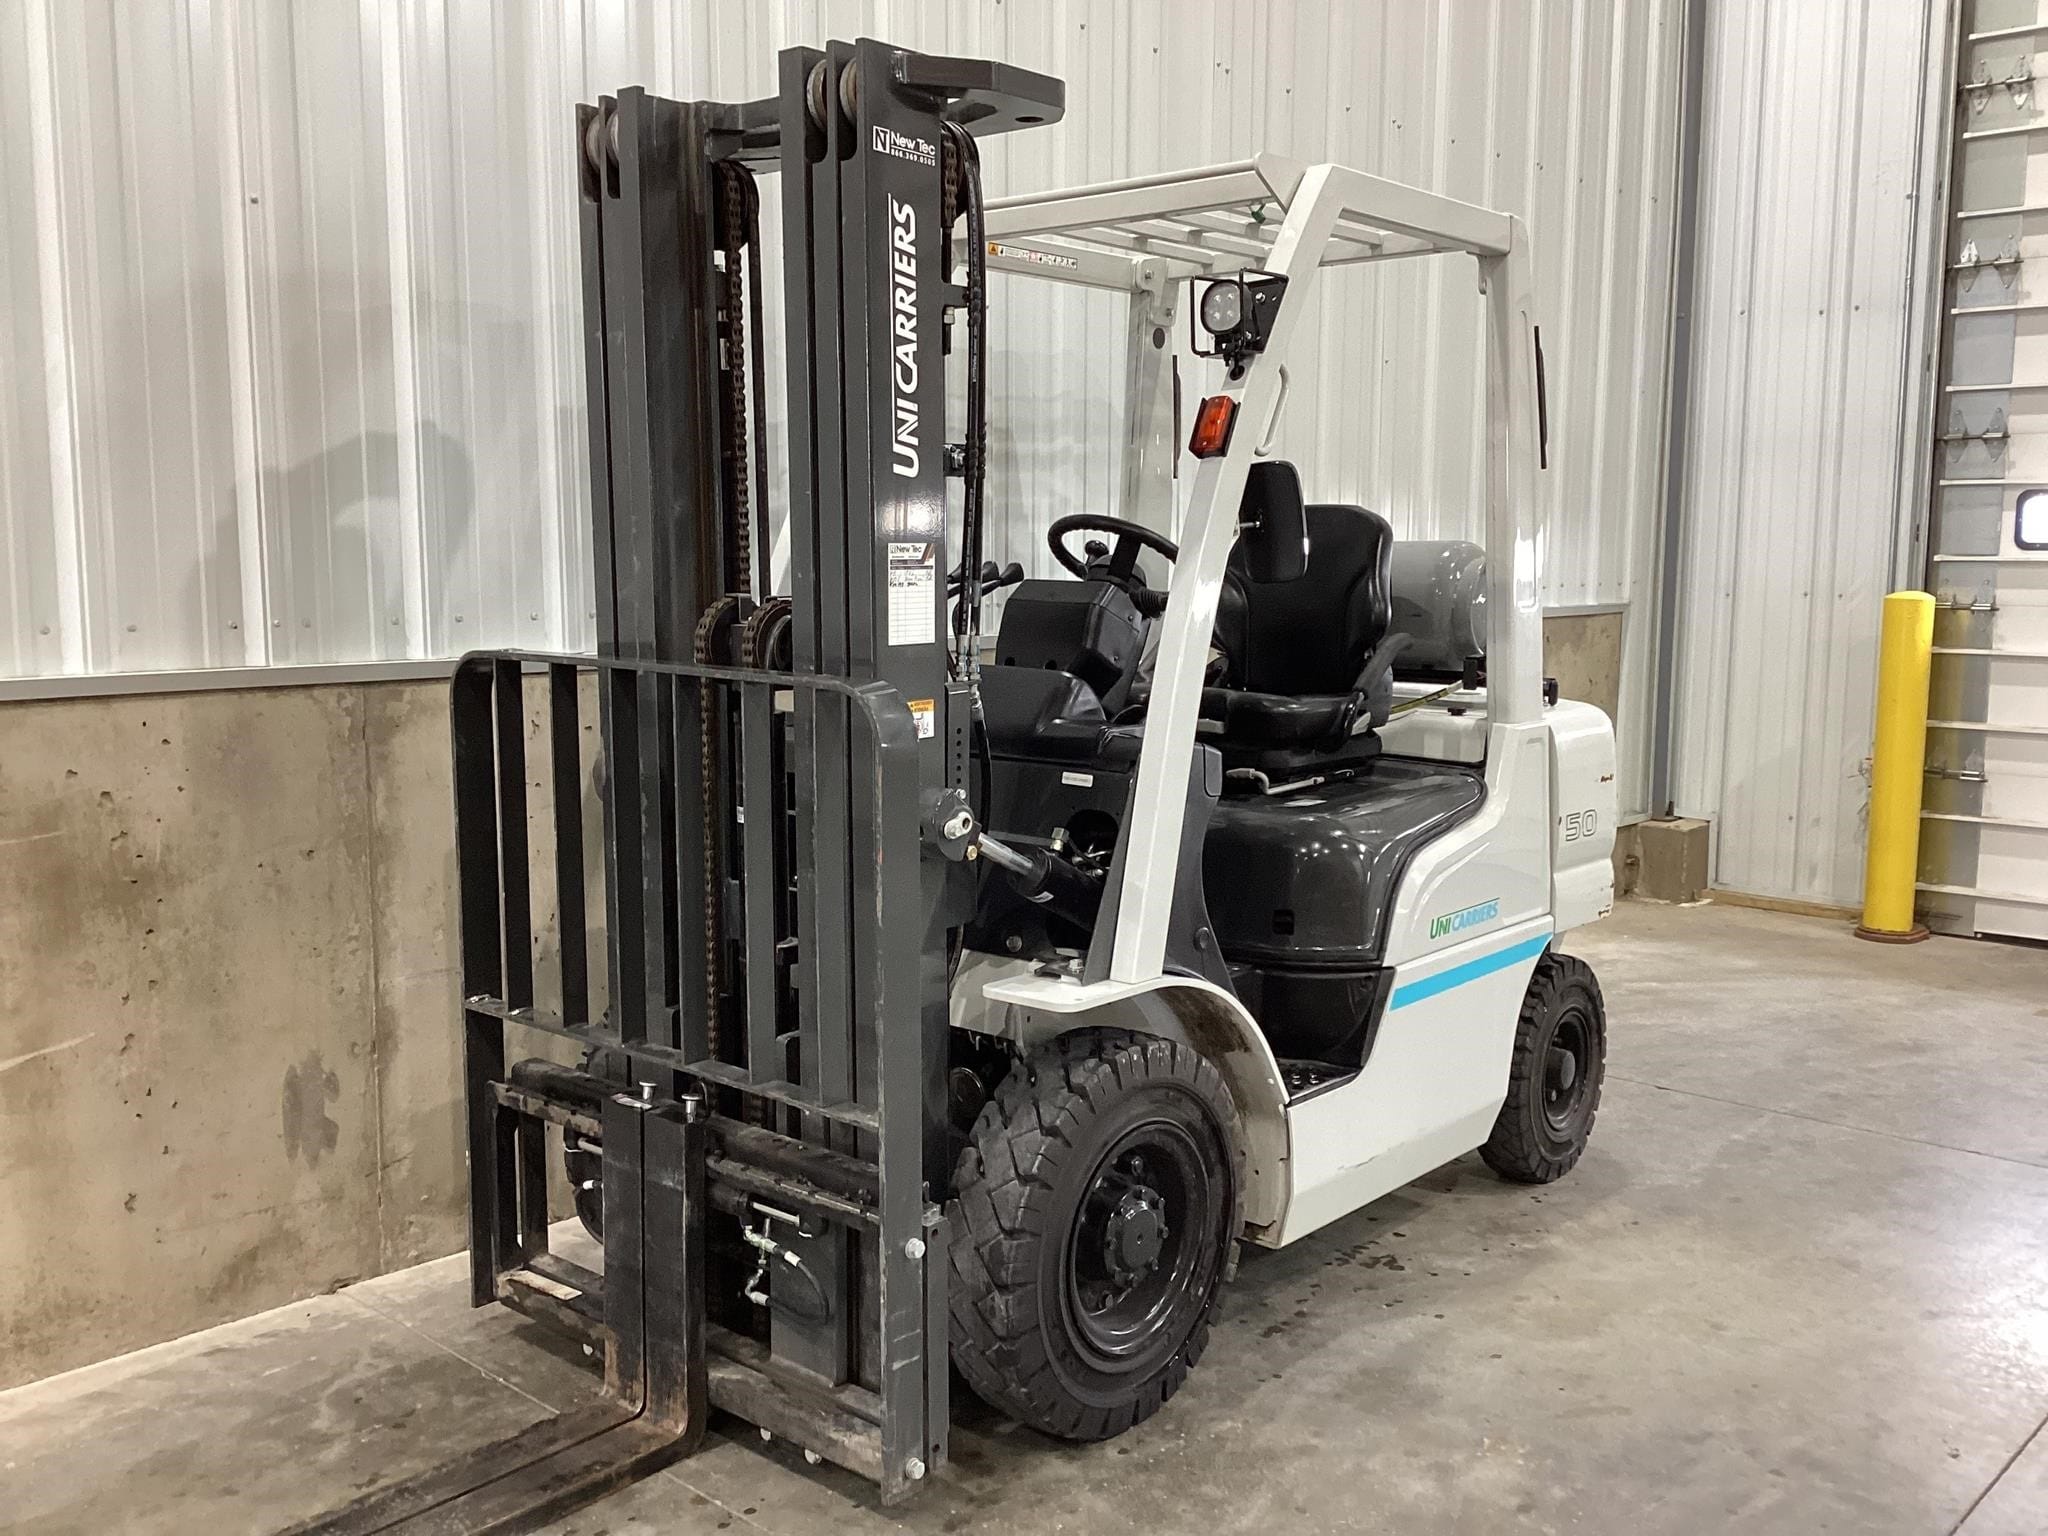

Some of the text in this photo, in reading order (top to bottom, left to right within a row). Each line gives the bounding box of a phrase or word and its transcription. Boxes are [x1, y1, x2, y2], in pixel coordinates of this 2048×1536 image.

[891, 130, 916, 150] New
[916, 137, 936, 156] Tec
[1565, 809, 1598, 842] 50
[1430, 899, 1499, 940] UNICARRIERS
